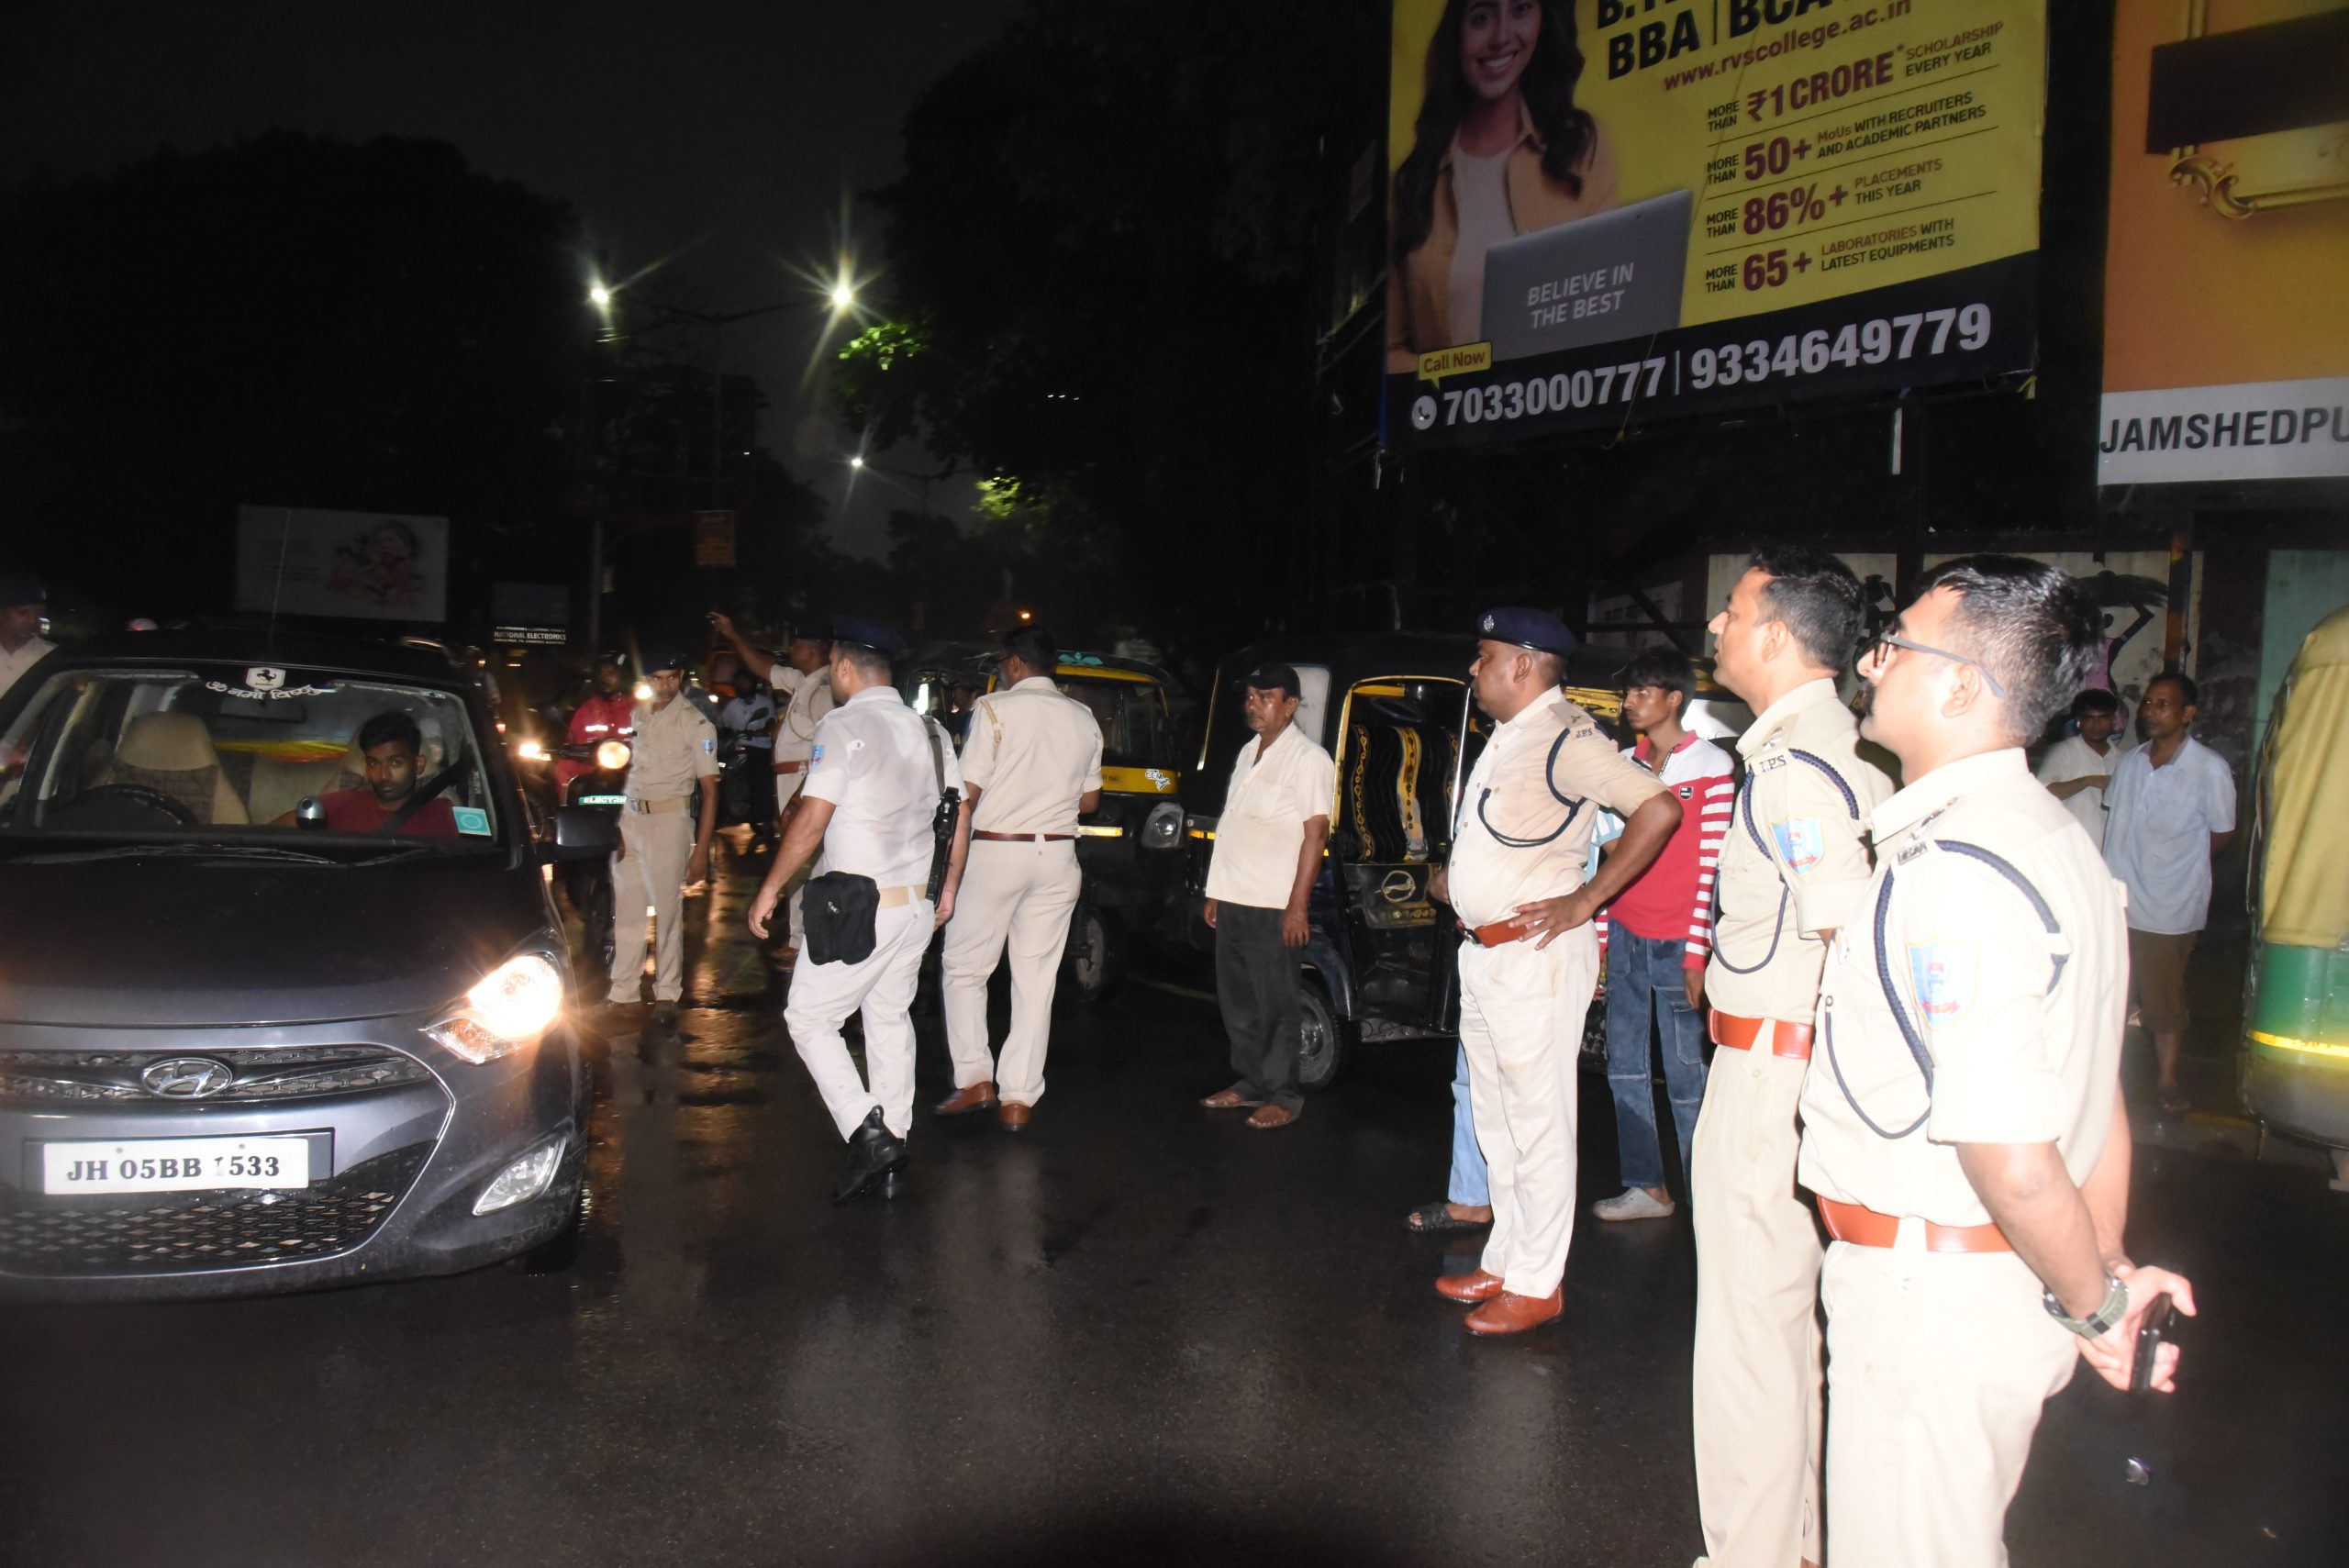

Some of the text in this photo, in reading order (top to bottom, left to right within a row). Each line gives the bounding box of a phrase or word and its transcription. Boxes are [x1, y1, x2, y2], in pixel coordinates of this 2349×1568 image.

[1609, 9, 1700, 80] BBA
[1664, 0, 1911, 91] www.rvscollege.ac.in
[1906, 41, 1991, 77] EVERY YEAR
[1907, 22, 2003, 61] SCHOLARSHIP
[1708, 100, 1740, 119] MORE
[1709, 115, 1737, 132] THAN
[1818, 92, 1974, 144] MoUs WITH RECRUITERS
[1818, 105, 1987, 159] AND ACADEMIC PARTNERS
[1707, 154, 1739, 172] MORE
[1708, 168, 1736, 185] THAN
[1745, 137, 1812, 181] 50+
[1854, 158, 1943, 189] PLACEMENTS
[1743, 183, 1849, 235] 86%+
[1855, 179, 1921, 205] THIS YEAR
[1707, 208, 1739, 225] MORE
[1707, 222, 1735, 239] THAN
[1821, 218, 1954, 256] LABORATORIES WITH
[1821, 234, 1955, 272] LATEST EQUIPMENTS
[1527, 262, 1634, 306] BELIEVE IN
[1706, 264, 1738, 281] MORE
[1706, 278, 1735, 294] THAN
[1743, 249, 1812, 291] 65+
[1531, 290, 1625, 328] THE BEST
[1424, 349, 1486, 373] Call Now
[1443, 303, 1991, 426] 7033000777 9334649779
[527, 632, 566, 640] ELECTRONICS
[66, 1160, 108, 1181] JH
[119, 1157, 202, 1179] 05BB
